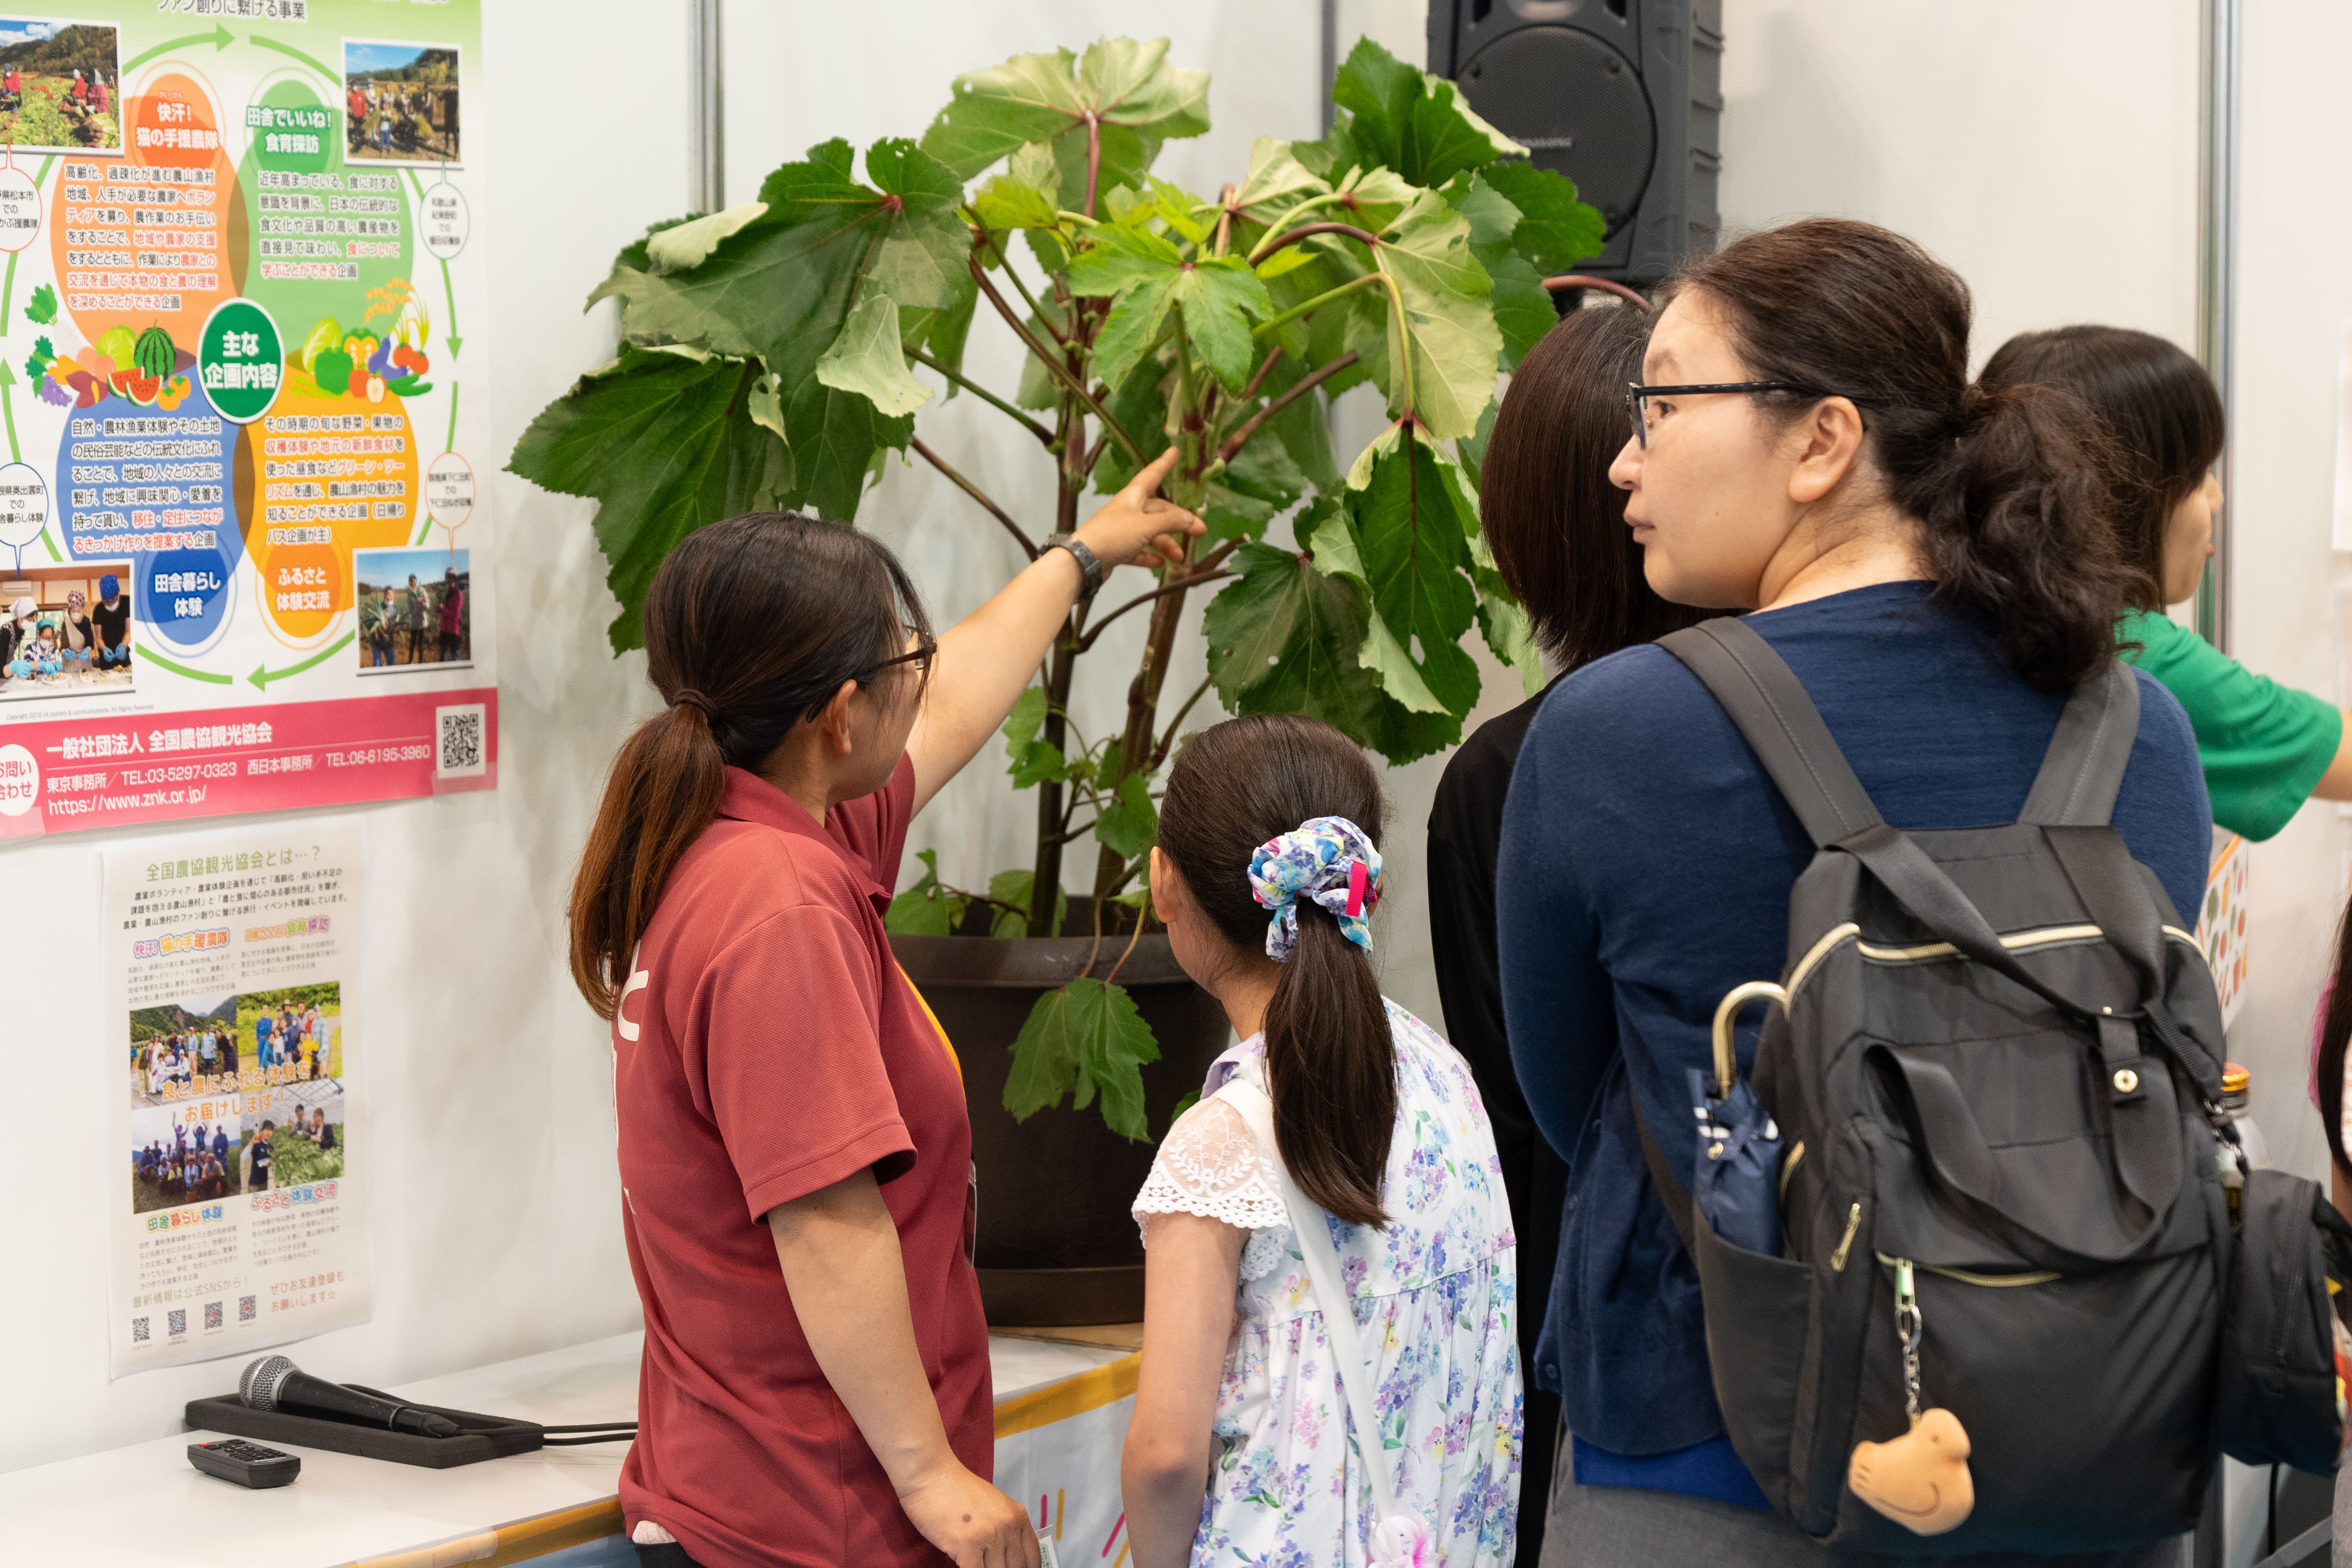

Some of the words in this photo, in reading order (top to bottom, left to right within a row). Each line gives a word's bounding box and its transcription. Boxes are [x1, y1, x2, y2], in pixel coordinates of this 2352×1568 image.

[157, 102, 191, 122] 快汗!
[248, 107, 331, 128] 田舎でいいね!
[136, 127, 218, 150] 猫の手援農隊
[265, 132, 319, 154] 食育探訪
[0, 190, 34, 201] 県松本市
[2, 204, 18, 214] での
[261, 264, 357, 278] 学ぶことができる企画
[69, 296, 180, 308] を深めることができる企画
[223, 330, 259, 357] 主な
[205, 362, 278, 388] 企画内容
[10, 500, 24, 509] での
[75, 532, 214, 551] るきっかけ作りを提案する企画
[155, 572, 220, 593] 田舎暮らし
[278, 567, 326, 585] ふるさと
[175, 598, 203, 617] 体験
[276, 591, 330, 610] 体験交流
[46, 732, 144, 760] 一般社団法人
[149, 721, 272, 753] 全国農協観光協会
[48, 785, 207, 816] https://www.znk.or.jp/
[162, 1061, 310, 1101] 食と農にふれる体験を
